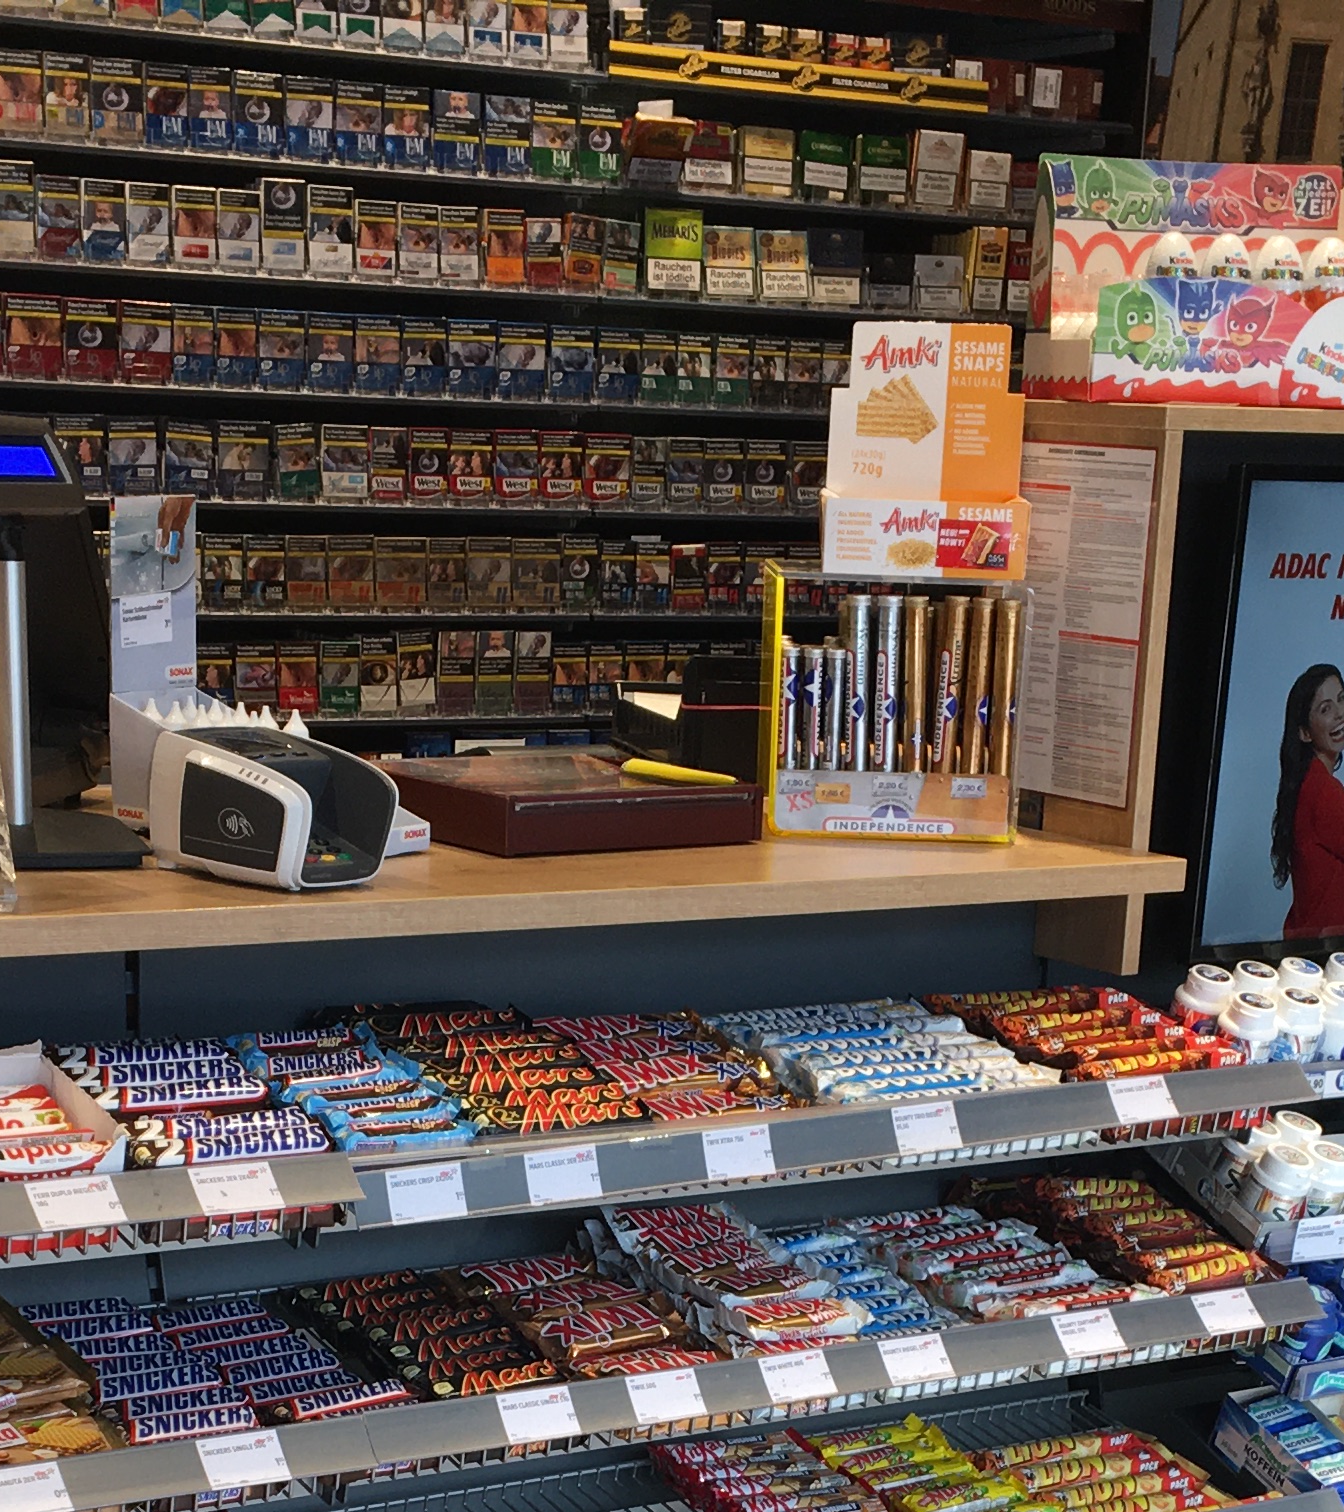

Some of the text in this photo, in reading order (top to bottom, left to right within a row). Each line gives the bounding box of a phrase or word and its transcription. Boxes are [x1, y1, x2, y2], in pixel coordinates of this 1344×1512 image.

[654, 262, 681, 275] Rauchen
[860, 335, 942, 373] Amki
[954, 341, 1005, 355] SESAME
[953, 356, 1004, 371] SNAPS
[951, 376, 1003, 388] NATURAL
[852, 462, 883, 478] 720g
[880, 507, 940, 535] Amki
[958, 507, 1014, 522] SESAME
[1270, 553, 1331, 580] ADAC
[169, 667, 193, 677] SONAX
[875, 660, 884, 757] INDEPENDENCE
[933, 657, 948, 757] INDEPENDENCE
[403, 828, 427, 839] SONAX
[833, 821, 944, 834] INDEPENDENCE
[111, 1058, 242, 1084] SNICKERS
[1219, 1051, 1242, 1067] PACK
[521, 1099, 642, 1135] Mars
[193, 1125, 327, 1159] SNICKERS
[464, 1254, 586, 1293] TWIX
[1186, 1250, 1249, 1280] LION
[229, 1350, 338, 1383] SNICKERS
[461, 1359, 556, 1397] Mars
[100, 1365, 219, 1400] SNICKERS
[1244, 1441, 1288, 1490] KOFFEIN
